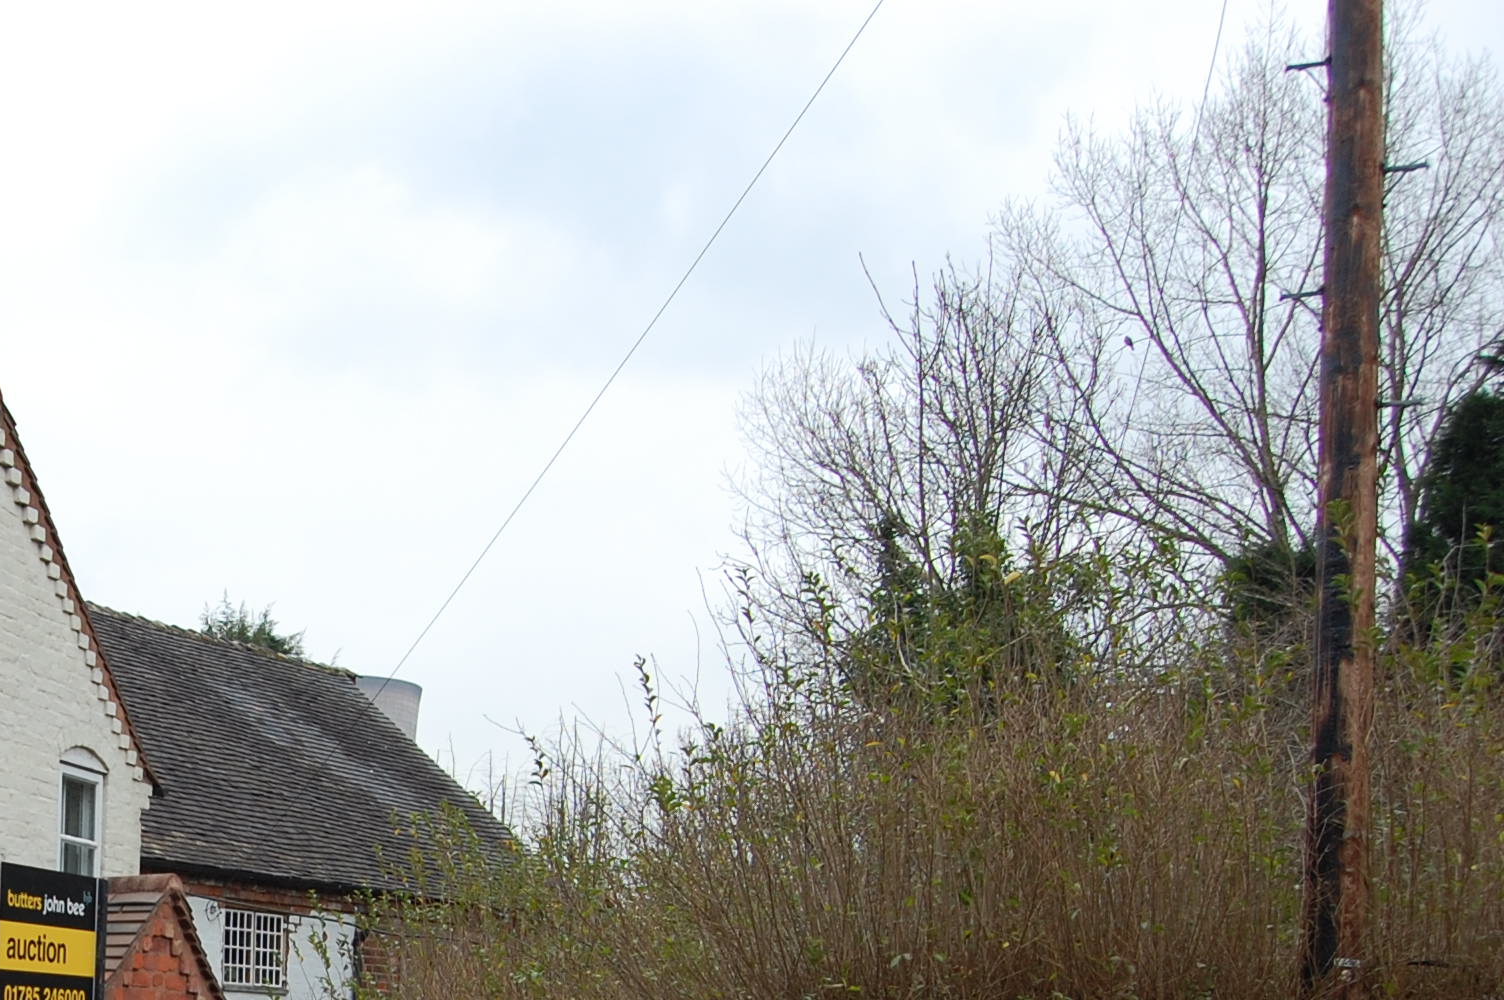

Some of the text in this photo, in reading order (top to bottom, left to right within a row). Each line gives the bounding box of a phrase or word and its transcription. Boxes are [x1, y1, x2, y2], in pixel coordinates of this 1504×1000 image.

[7, 888, 43, 911] butters
[42, 894, 66, 916] john
[66, 898, 86, 917] bee
[6, 933, 67, 965] auction
